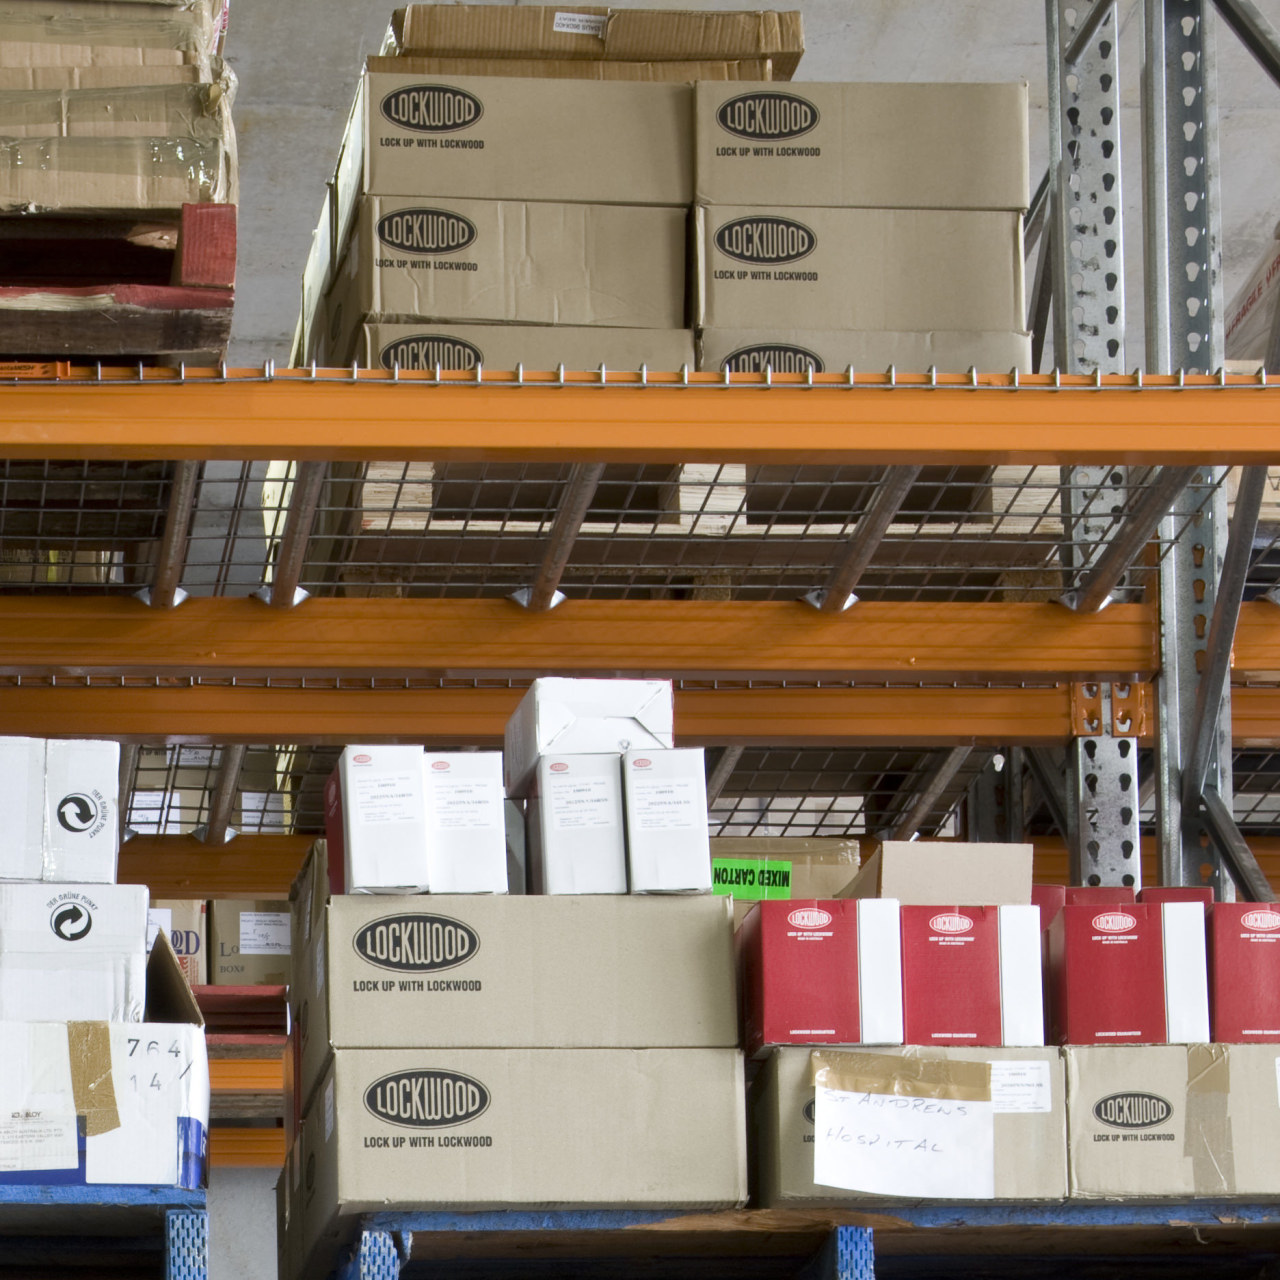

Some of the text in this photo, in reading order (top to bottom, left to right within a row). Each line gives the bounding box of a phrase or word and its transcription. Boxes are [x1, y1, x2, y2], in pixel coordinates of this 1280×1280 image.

[391, 91, 474, 126] LOCKWOOD
[727, 99, 811, 134] LOCKWOOD
[381, 138, 484, 149] LOCK UP WITH LOCKWOOD
[716, 147, 820, 157] LOCK UP WITH LOCKWOOD
[385, 214, 469, 248] LOCKWOOD
[724, 223, 808, 258] LOCKWOOD
[376, 258, 478, 271] LOCK UP WITH LOCKWOOD
[714, 270, 818, 281] LOCK UP WITH LOCKWOOD
[714, 867, 790, 888] MIXED CARTON
[792, 912, 828, 925] LOCKWOOD
[934, 916, 969, 930] LOCKWOOD
[1097, 915, 1132, 929] LOCKWOOD
[366, 921, 468, 965] LOCKWOOD
[354, 980, 481, 992] LOCK UP WITH LOCKWOOD
[377, 1077, 479, 1120] LOCKWOOD
[859, 1092, 967, 1116] ANDREWS
[1102, 1097, 1166, 1124] LOCKWOOD
[364, 1136, 492, 1148] LOCK UP WITH LOCKWOOD
[1094, 1134, 1110, 1142] LOCK
